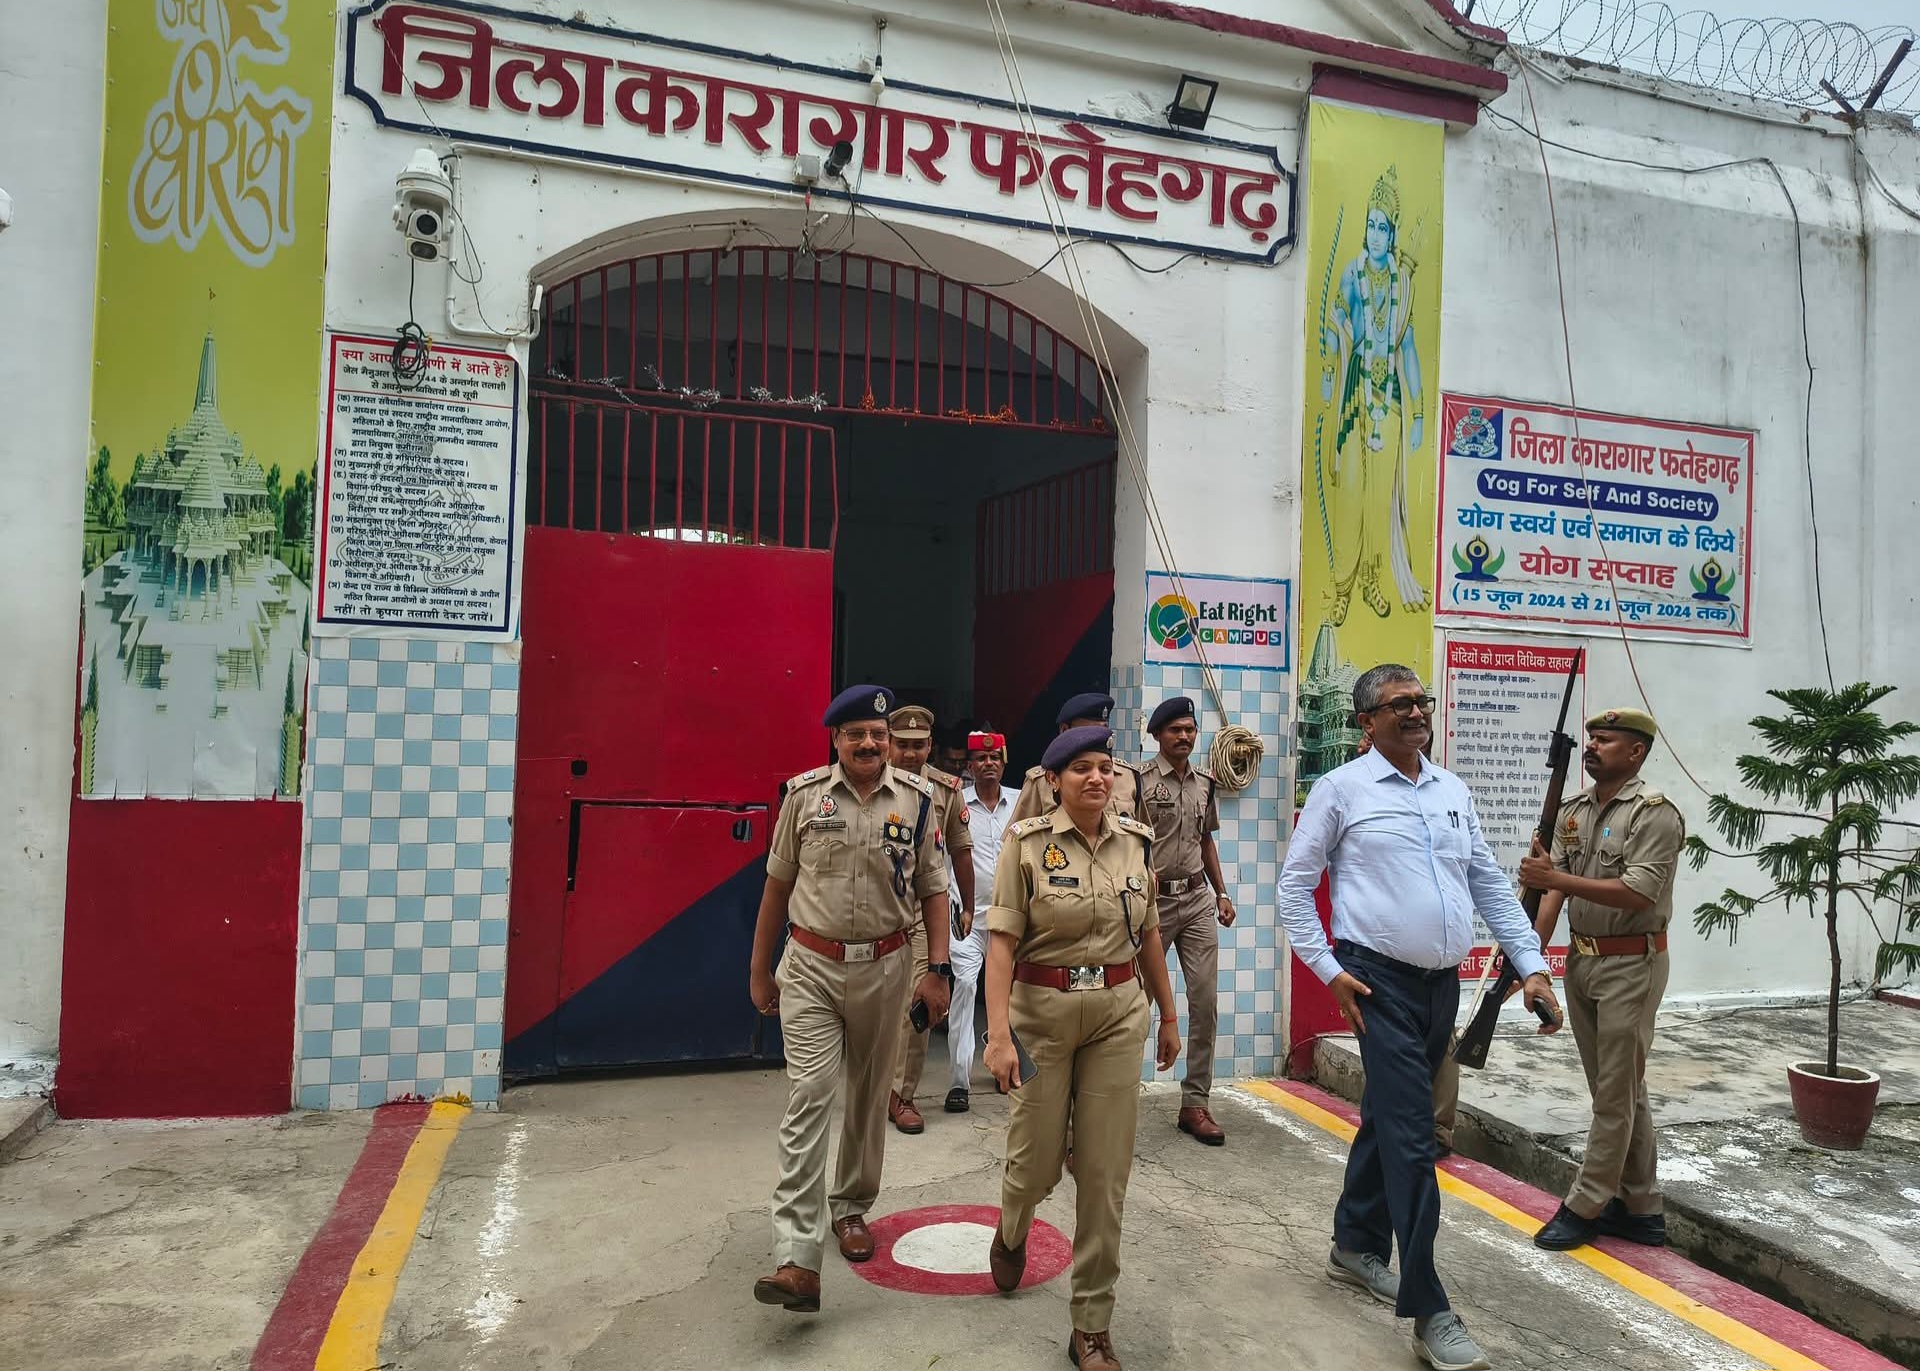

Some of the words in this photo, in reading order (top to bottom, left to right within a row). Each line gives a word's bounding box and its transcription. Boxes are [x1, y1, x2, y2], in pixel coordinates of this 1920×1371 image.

[373, 4, 614, 127] जिला
[614, 60, 955, 184] कारागार
[960, 122, 1281, 242] फतेहगढ़
[341, 349, 363, 361] क्या
[450, 357, 461, 372] में
[465, 359, 489, 375] आते
[370, 378, 379, 388] से
[449, 387, 460, 397] की
[439, 374, 447, 384] के
[386, 418, 394, 427] के
[1509, 417, 1566, 464] जिला
[1571, 436, 1654, 475] कारागार
[1658, 440, 1740, 494] फतेहगढ़
[1483, 474, 1519, 496] Yog
[1526, 477, 1557, 496] For
[1563, 480, 1599, 502] Self
[1606, 488, 1640, 506] And
[1647, 491, 1714, 515] Society
[1458, 502, 1504, 531] योग
[1509, 510, 1556, 536] स्वयं
[1562, 514, 1592, 540] एवं
[1598, 523, 1661, 546] समाज
[1667, 524, 1689, 549] के
[1695, 525, 1735, 553] लिये
[1520, 546, 1579, 579] योग
[1588, 557, 1678, 588] सप्ताह
[393, 583, 401, 592] के
[470, 587, 477, 596] के
[419, 595, 427, 604] के
[359, 603, 371, 615] तो
[374, 608, 403, 621] कृपया
[406, 606, 439, 619] तलाशी
[442, 608, 465, 620] देकर
[1200, 601, 1224, 620] Eat
[1228, 602, 1277, 626] Right
[1452, 582, 1480, 605] (15
[1487, 588, 1523, 611] जून
[1529, 592, 1565, 609] 2024
[1570, 592, 1590, 610] से
[1593, 596, 1611, 612] 21
[1617, 598, 1652, 622] जून
[1657, 602, 1691, 618] 2024
[1696, 602, 1737, 627] तक)
[1201, 629, 1280, 644] CAMPUS
[1481, 649, 1492, 665] को
[1494, 653, 1515, 667] प्राप्त
[1517, 650, 1545, 668] विधिक
